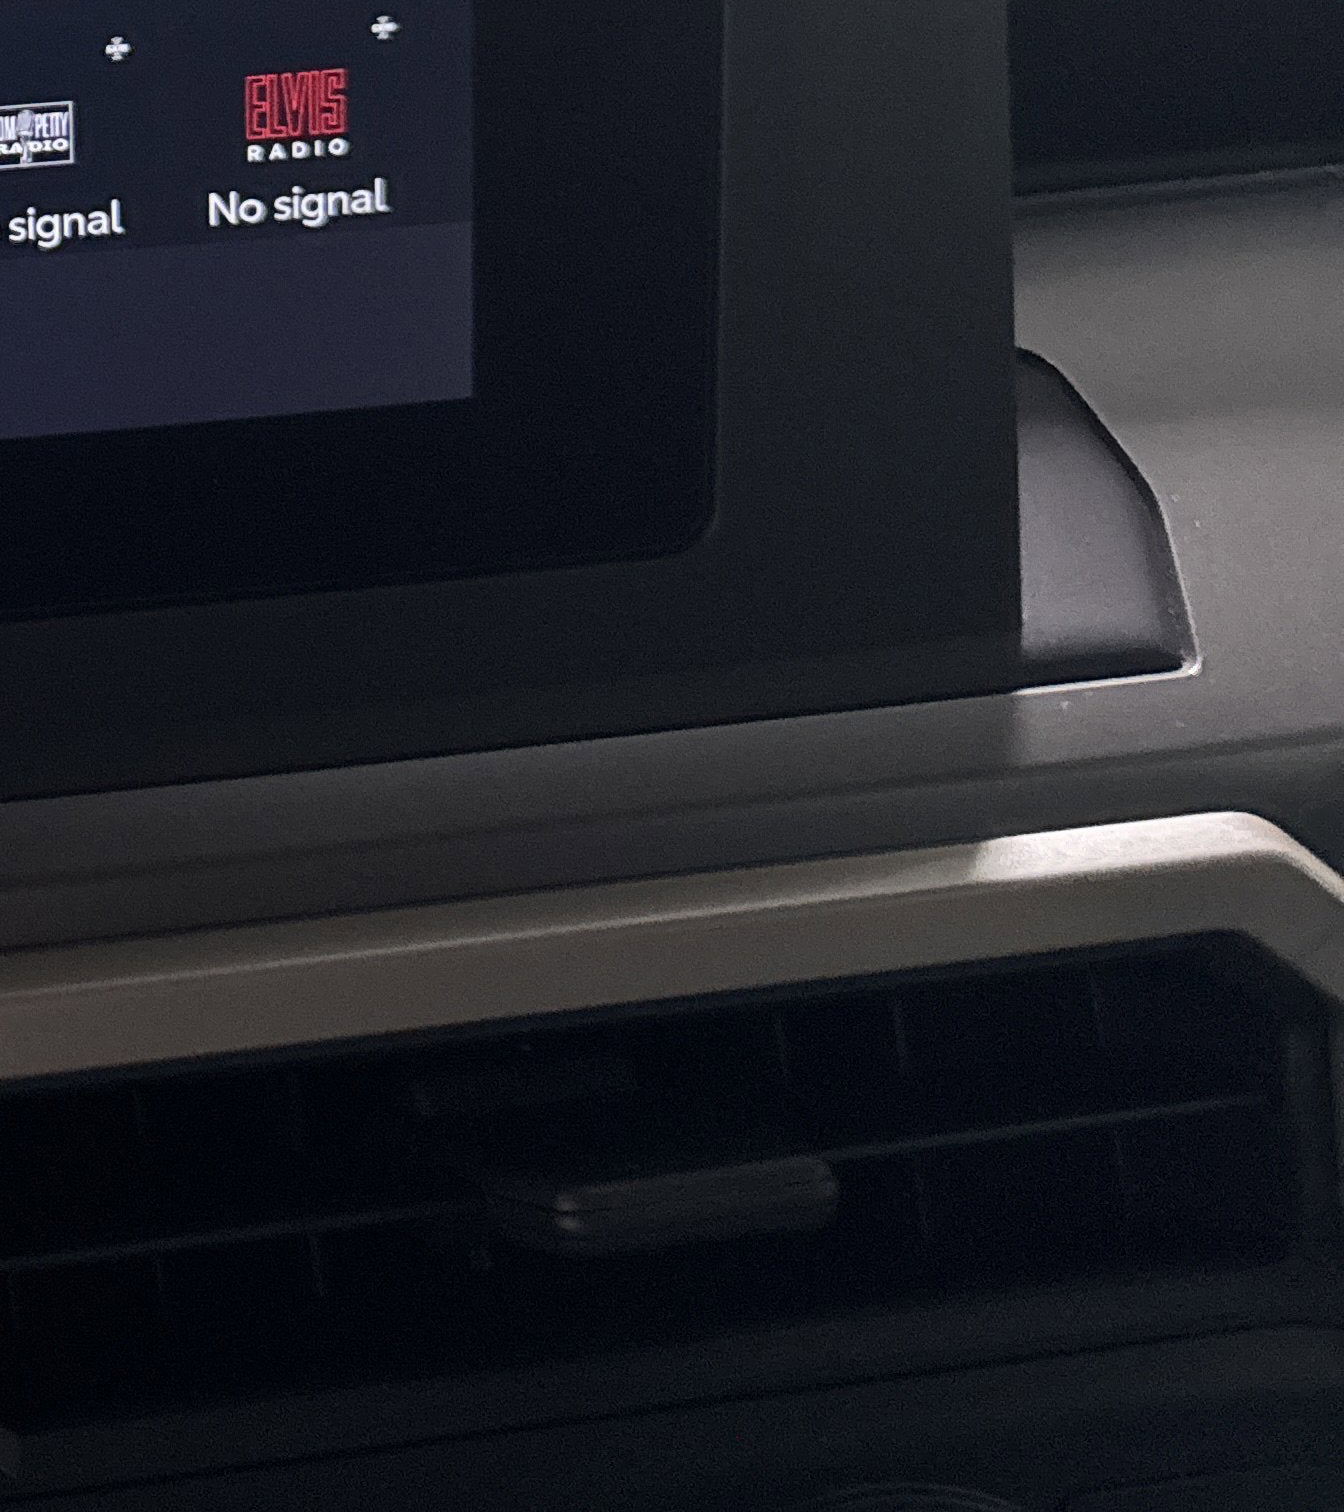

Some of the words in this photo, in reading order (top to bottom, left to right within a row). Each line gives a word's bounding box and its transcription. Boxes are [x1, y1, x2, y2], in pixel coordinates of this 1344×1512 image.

[33, 111, 71, 139] PETTY
[244, 67, 349, 141] ELVIS
[246, 137, 351, 163] RADIO
[7, 197, 126, 250] signal
[207, 189, 267, 228] No
[272, 176, 391, 229] signal
